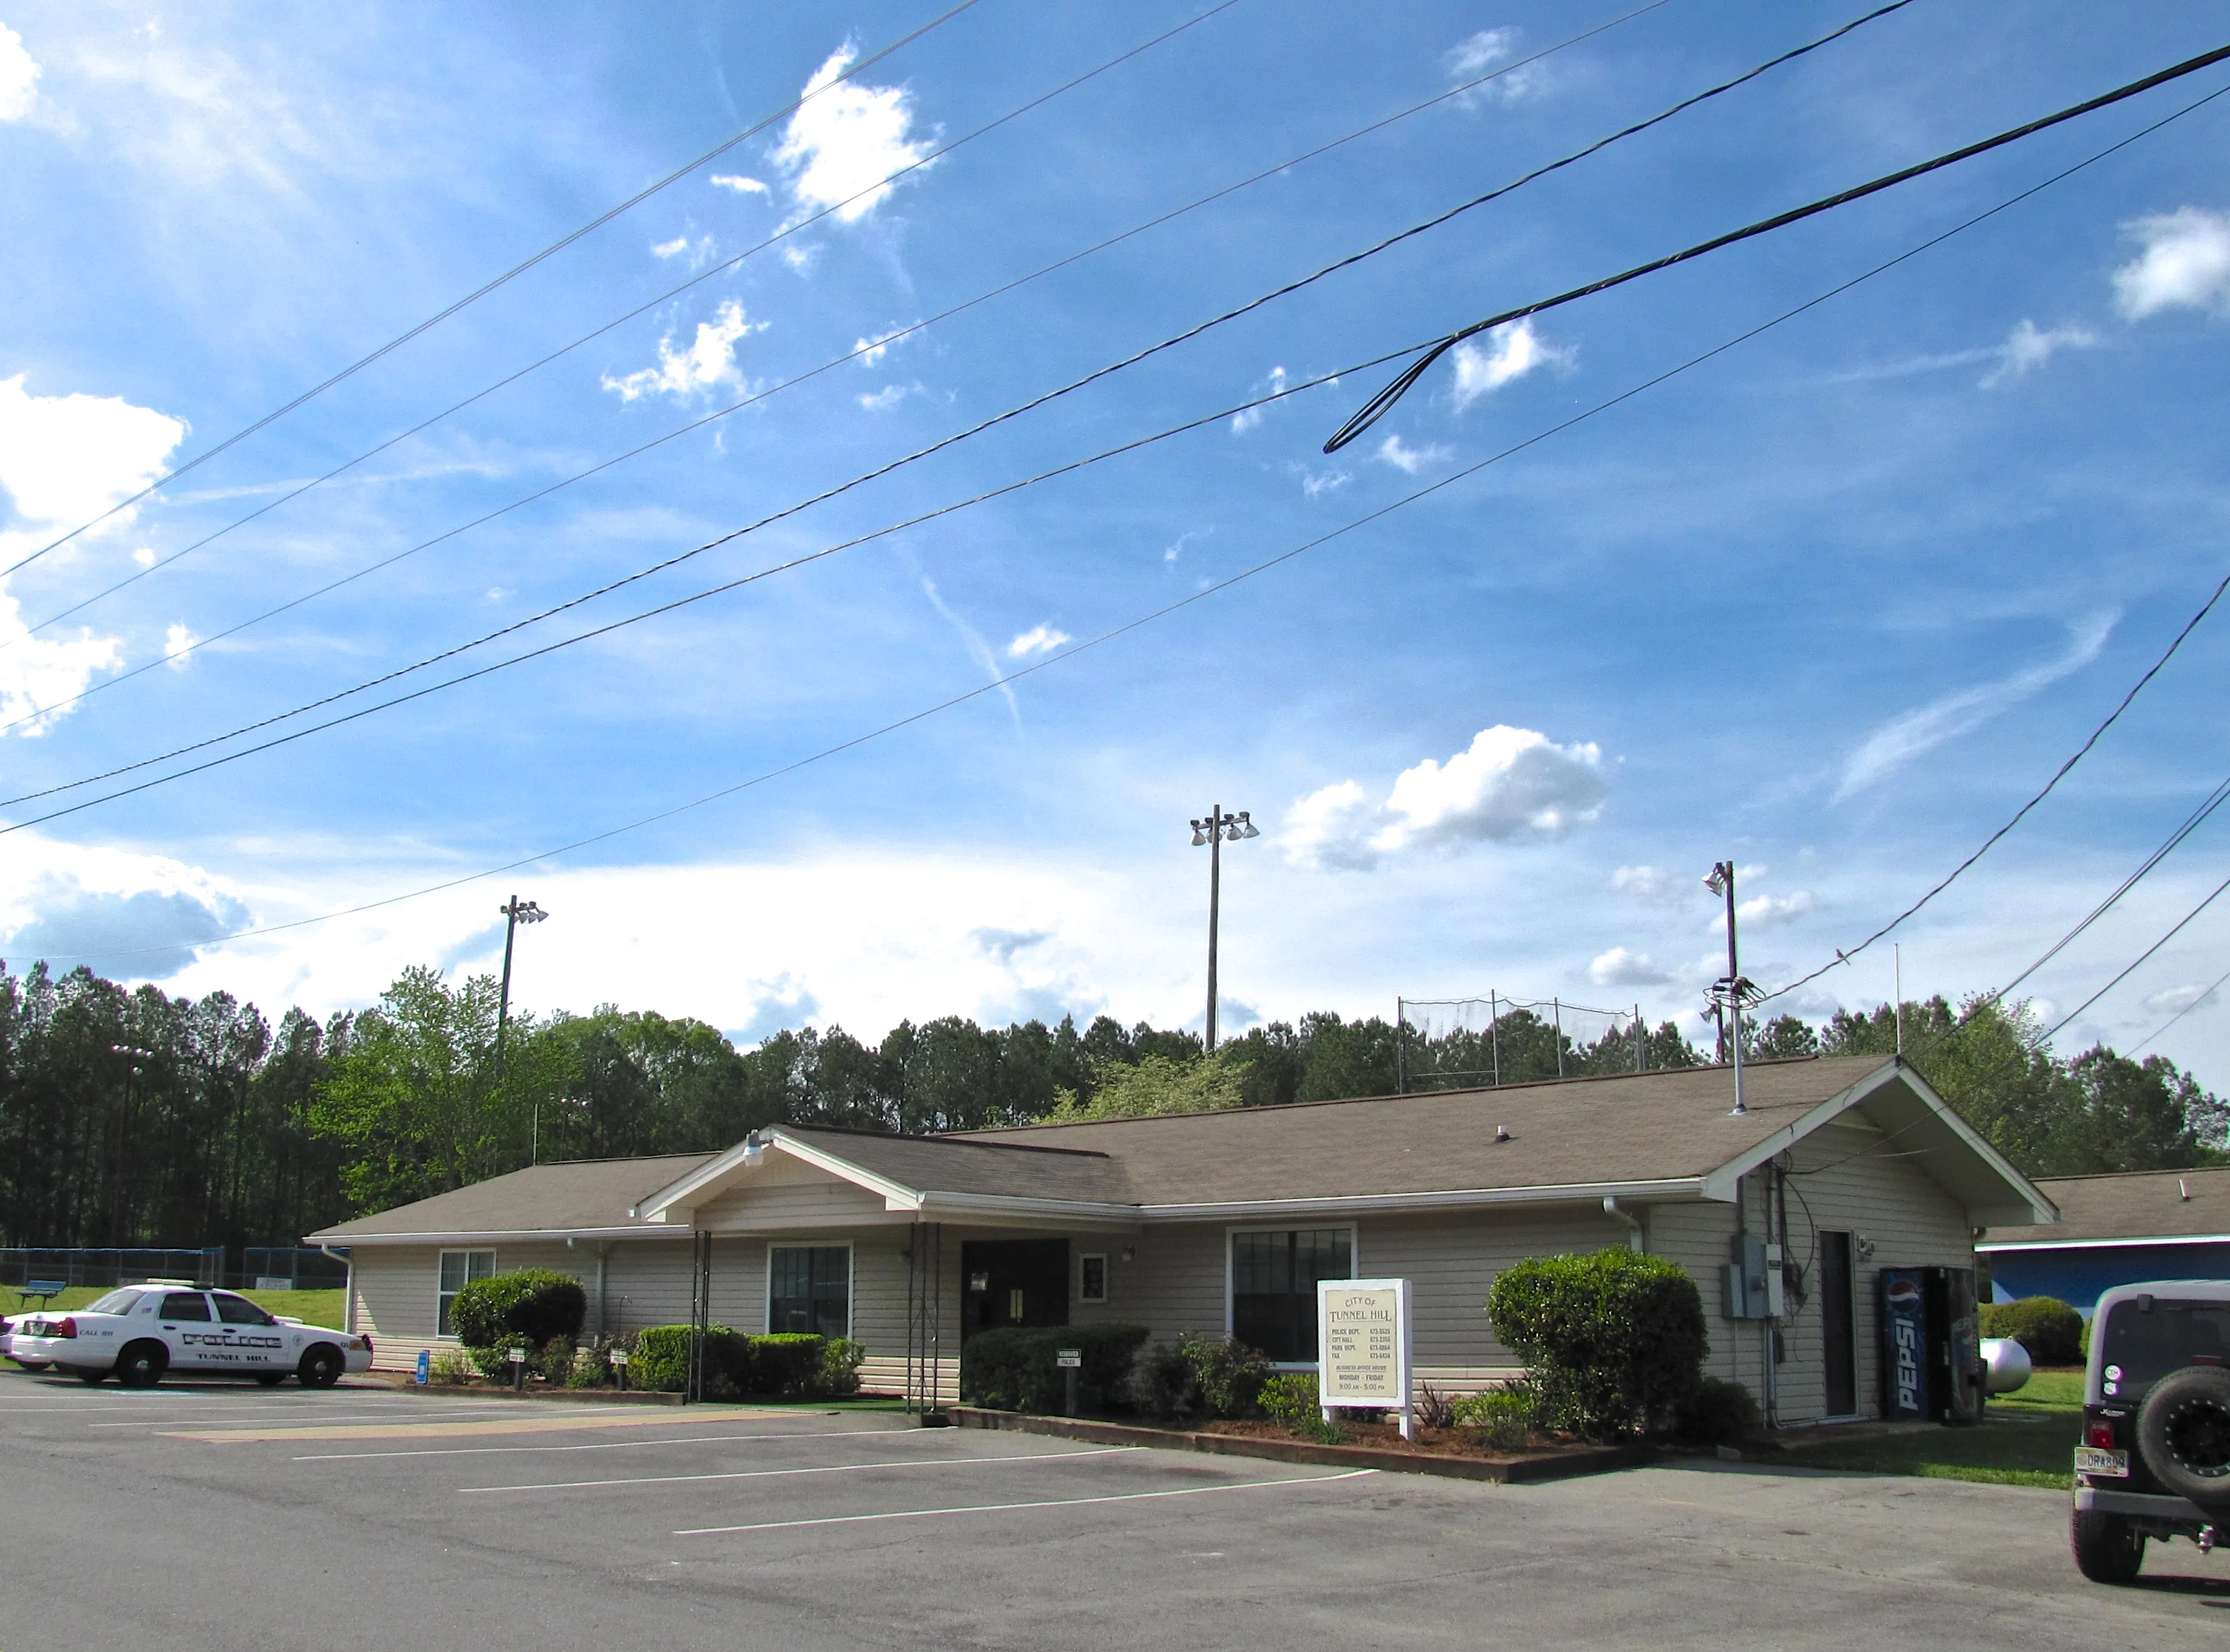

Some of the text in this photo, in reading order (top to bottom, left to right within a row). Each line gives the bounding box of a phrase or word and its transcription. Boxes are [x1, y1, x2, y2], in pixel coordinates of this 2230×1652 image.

[1345, 1297, 1376, 1307] CITY OF
[1330, 1310, 1391, 1322] TUNNEL HILL
[182, 1333, 283, 1348] POLICE
[1895, 1318, 1918, 1410] PEPSI
